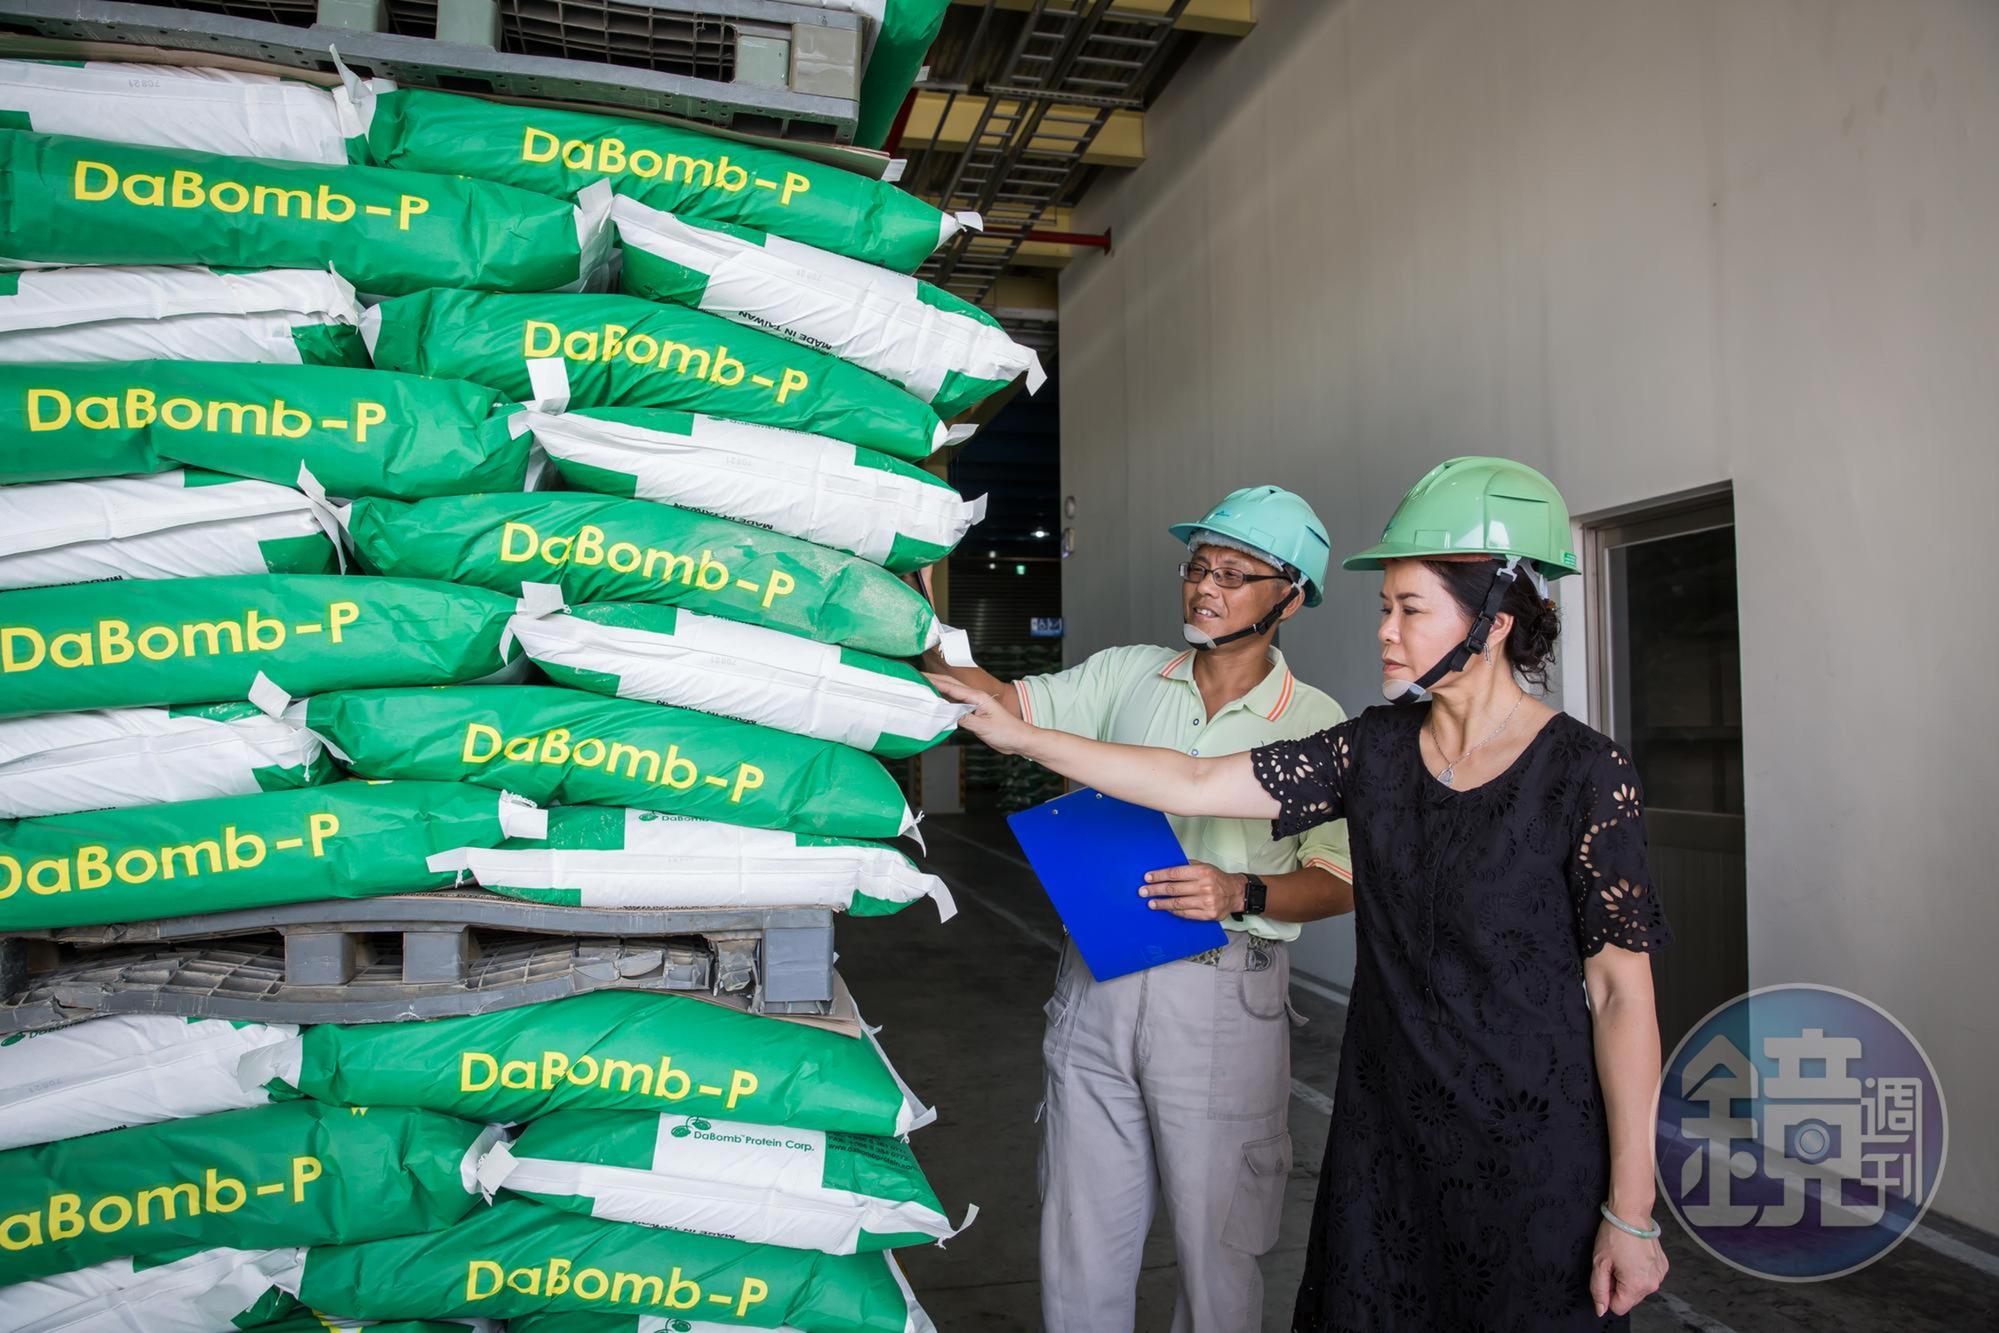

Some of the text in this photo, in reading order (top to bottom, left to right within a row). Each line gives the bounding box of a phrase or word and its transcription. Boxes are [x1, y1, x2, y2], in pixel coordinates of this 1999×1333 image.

[75, 160, 429, 230] DaBomb-P
[522, 126, 811, 205] DaBomb-P
[524, 320, 809, 403] DaBomb-P
[799, 332, 832, 351] MADE
[27, 388, 387, 443] DaBomb-P
[500, 522, 795, 609] DaBomb-P
[1, 601, 361, 674] DaBomb-P
[462, 722, 765, 803] DaBomb-P
[460, 1050, 759, 1108] DaBomb-P
[745, 1135, 782, 1148] Protein
[785, 1139, 815, 1152] Corp.
[0, 1156, 322, 1252] aBomb-P
[465, 1259, 769, 1317] DaBomb-P
